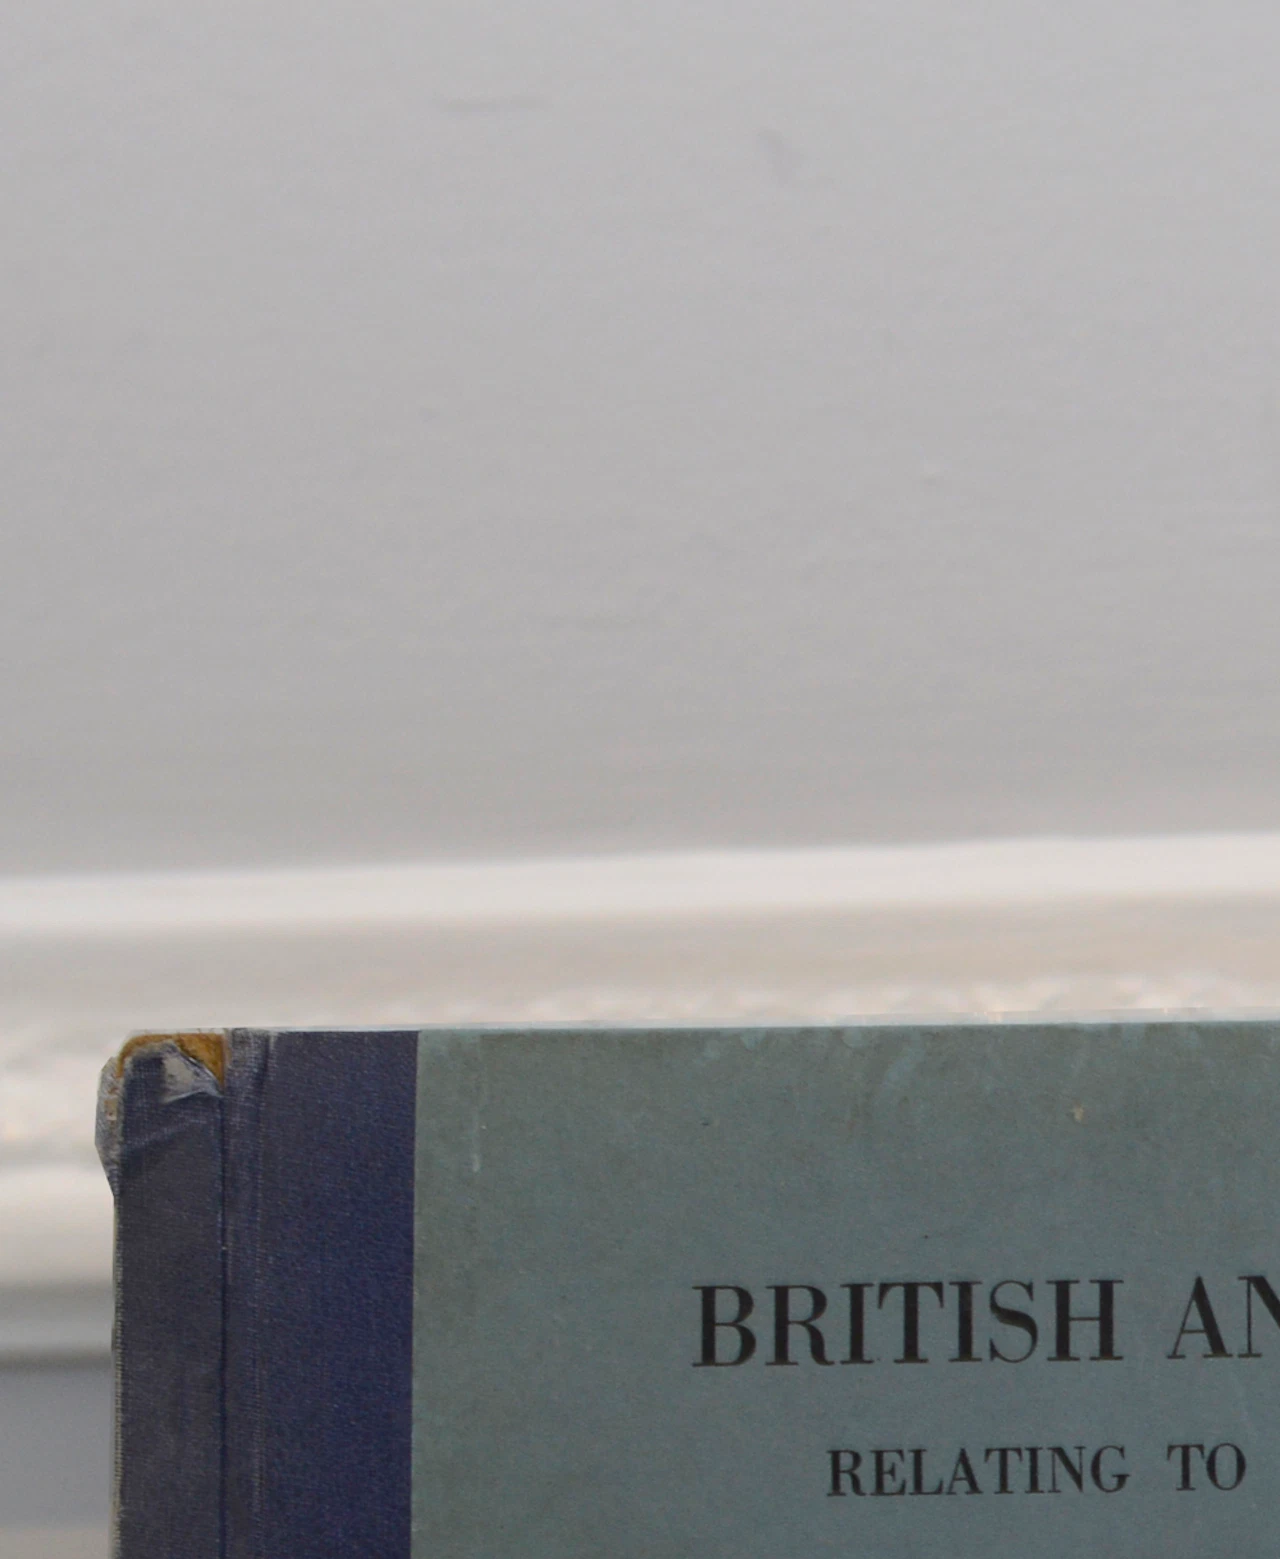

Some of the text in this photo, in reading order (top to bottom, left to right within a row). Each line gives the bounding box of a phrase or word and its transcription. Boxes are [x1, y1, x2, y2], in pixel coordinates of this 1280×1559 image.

[692, 1279, 1124, 1367] BRITISH
[826, 1445, 1131, 1497] RELATING
[1167, 1442, 1247, 1492] TO
